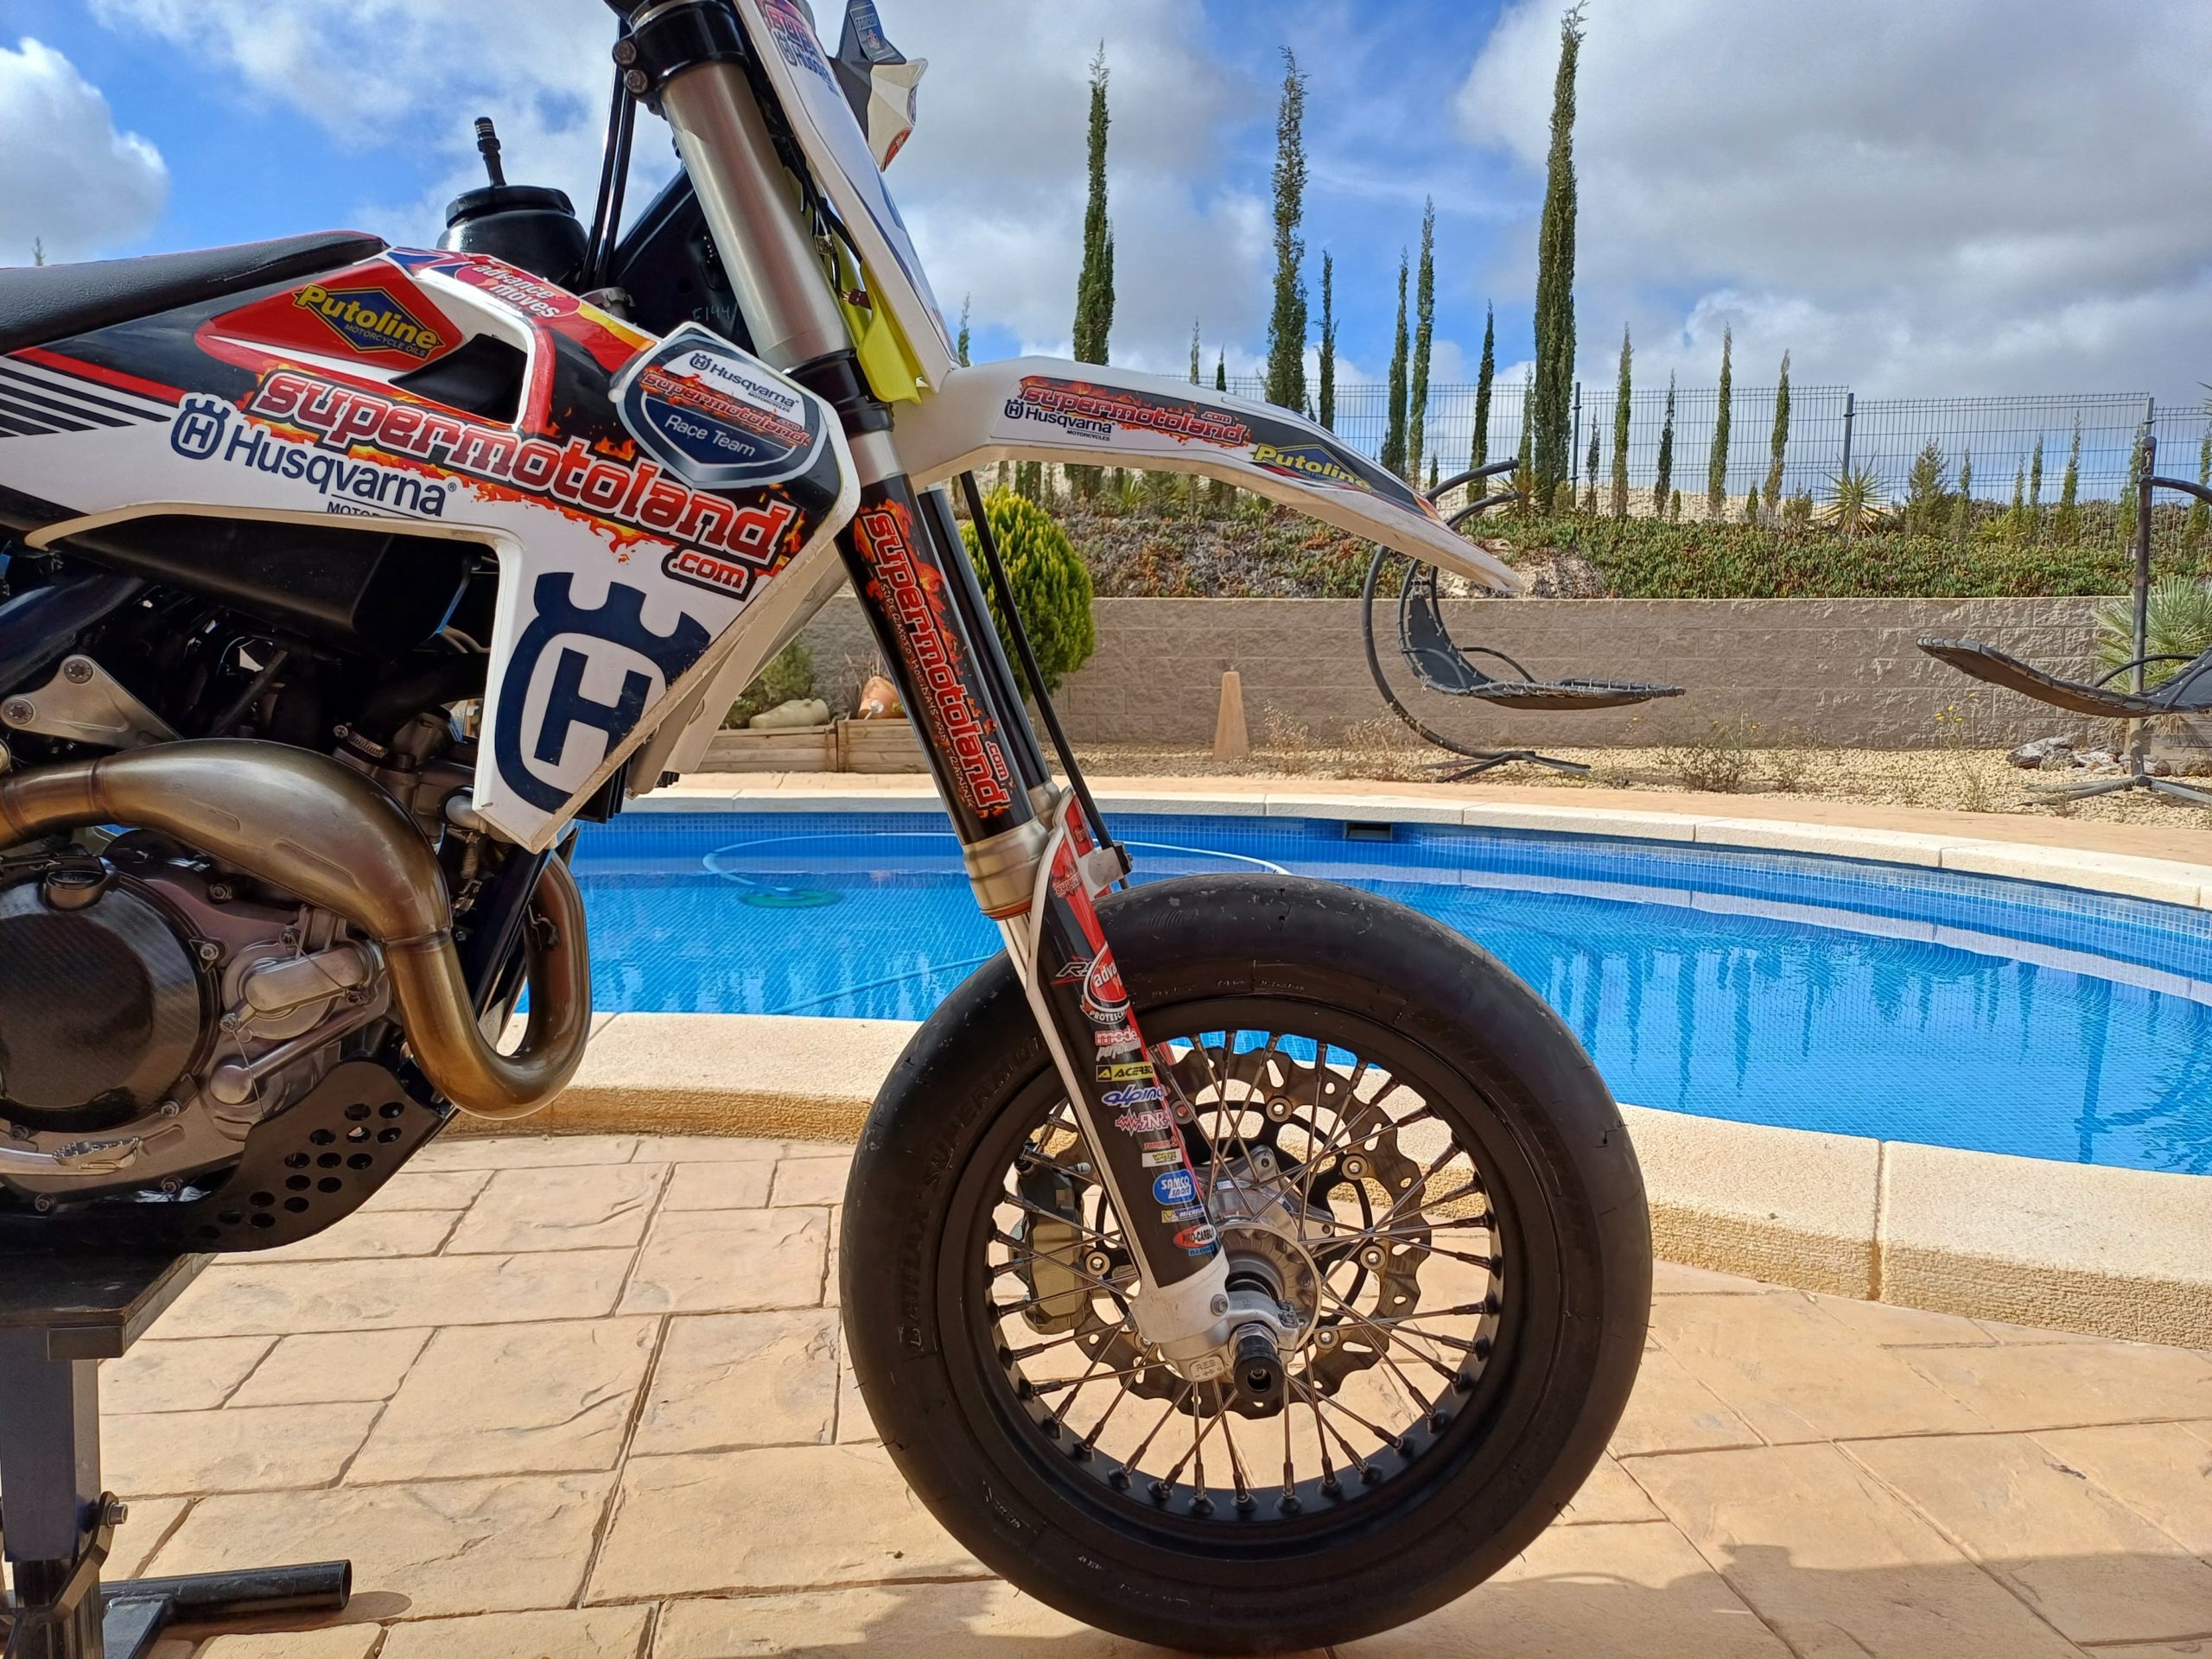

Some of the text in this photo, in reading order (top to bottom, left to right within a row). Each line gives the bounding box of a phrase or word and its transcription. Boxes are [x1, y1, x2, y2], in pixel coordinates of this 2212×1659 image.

[472, 264, 554, 300] advance
[489, 283, 561, 318] moves
[297, 284, 439, 350] Putoline
[345, 323, 426, 358] MOTORCYCLE OILS
[709, 364, 795, 409] Husqvarna
[644, 373, 810, 446] supermotoland
[1022, 387, 1245, 444] supermotoland
[1026, 406, 1112, 434] Husqvarna
[664, 414, 756, 457] Race Team
[1066, 429, 1110, 442] MOTORCYCLES
[224, 424, 447, 518] Husqvarna
[256, 374, 795, 564] supermotoland
[671, 552, 743, 590] .com
[865, 512, 1009, 810] supermotoland
[881, 582, 912, 656] SUPERMOTO
[912, 658, 939, 717] HOLIDAYS
[935, 720, 948, 742] AND
[987, 741, 1009, 781] .com
[1161, 1176, 1191, 1190] SAMCO
[1172, 1186, 1191, 1198] sport
